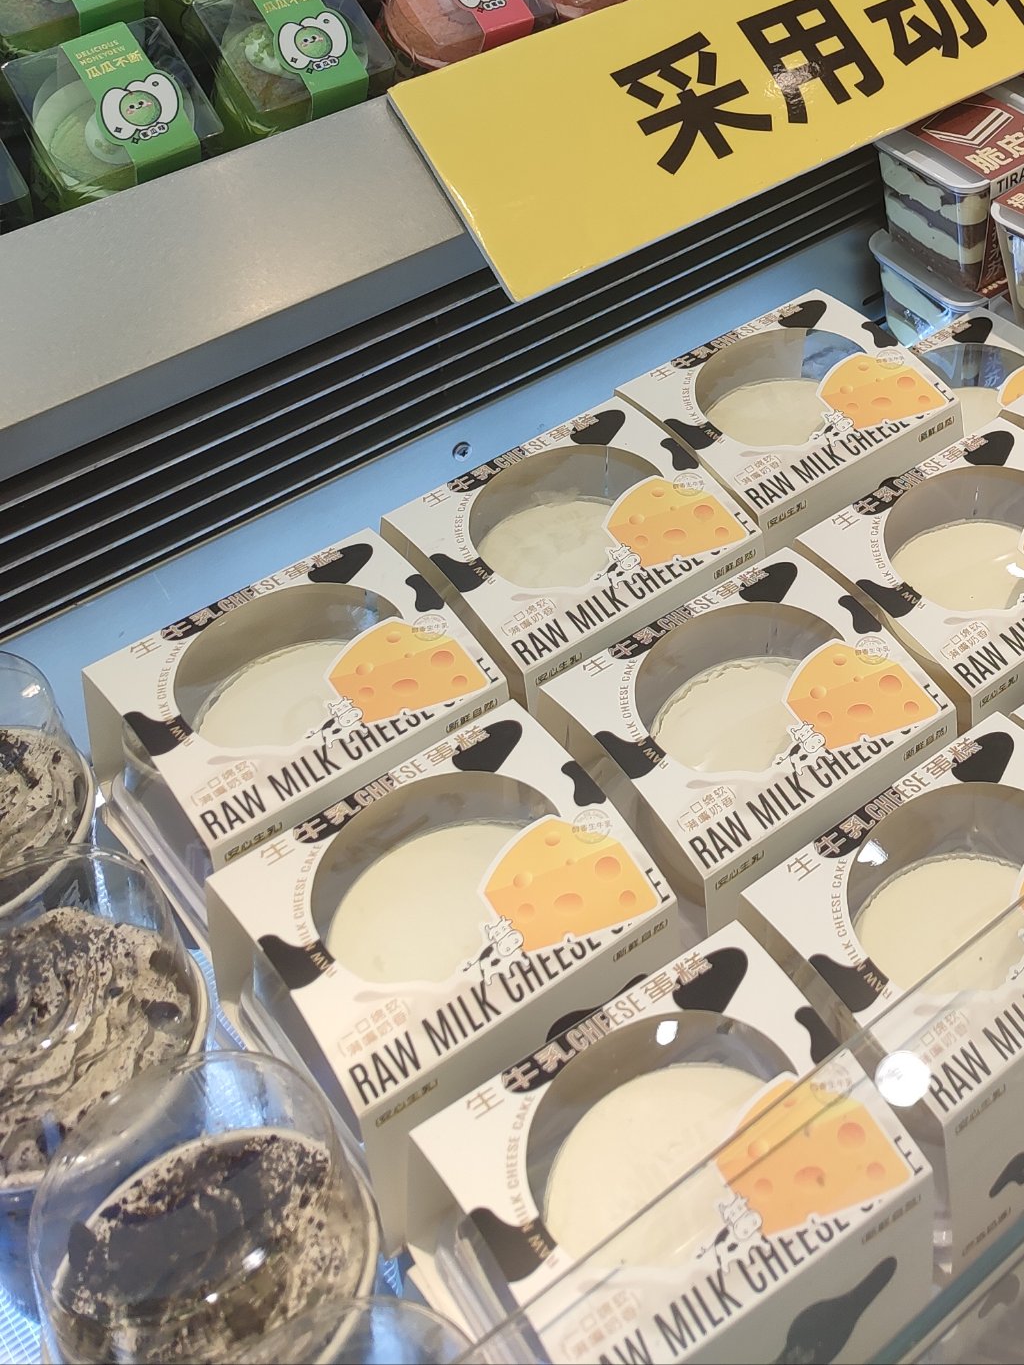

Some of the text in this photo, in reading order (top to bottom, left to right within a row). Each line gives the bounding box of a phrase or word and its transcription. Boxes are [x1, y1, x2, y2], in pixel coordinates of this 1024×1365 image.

[85, 51, 144, 81] 瓜瓜不断
[459, 493, 474, 516] CAKE
[744, 475, 795, 511] RAW
[791, 448, 845, 480] MILK
[454, 518, 466, 547] CHEESE
[512, 619, 568, 665] RAW
[565, 588, 626, 629] MILK
[954, 639, 1007, 688] RAW
[199, 784, 267, 840] RAW
[268, 745, 341, 801] MILK
[689, 811, 748, 868] RAW
[746, 773, 816, 830] MILK
[349, 1031, 422, 1105] RAW
[422, 983, 502, 1057] MILK
[928, 1042, 987, 1112] RAW
[598, 1329, 649, 1365] AW
[654, 1279, 743, 1358] MILK
